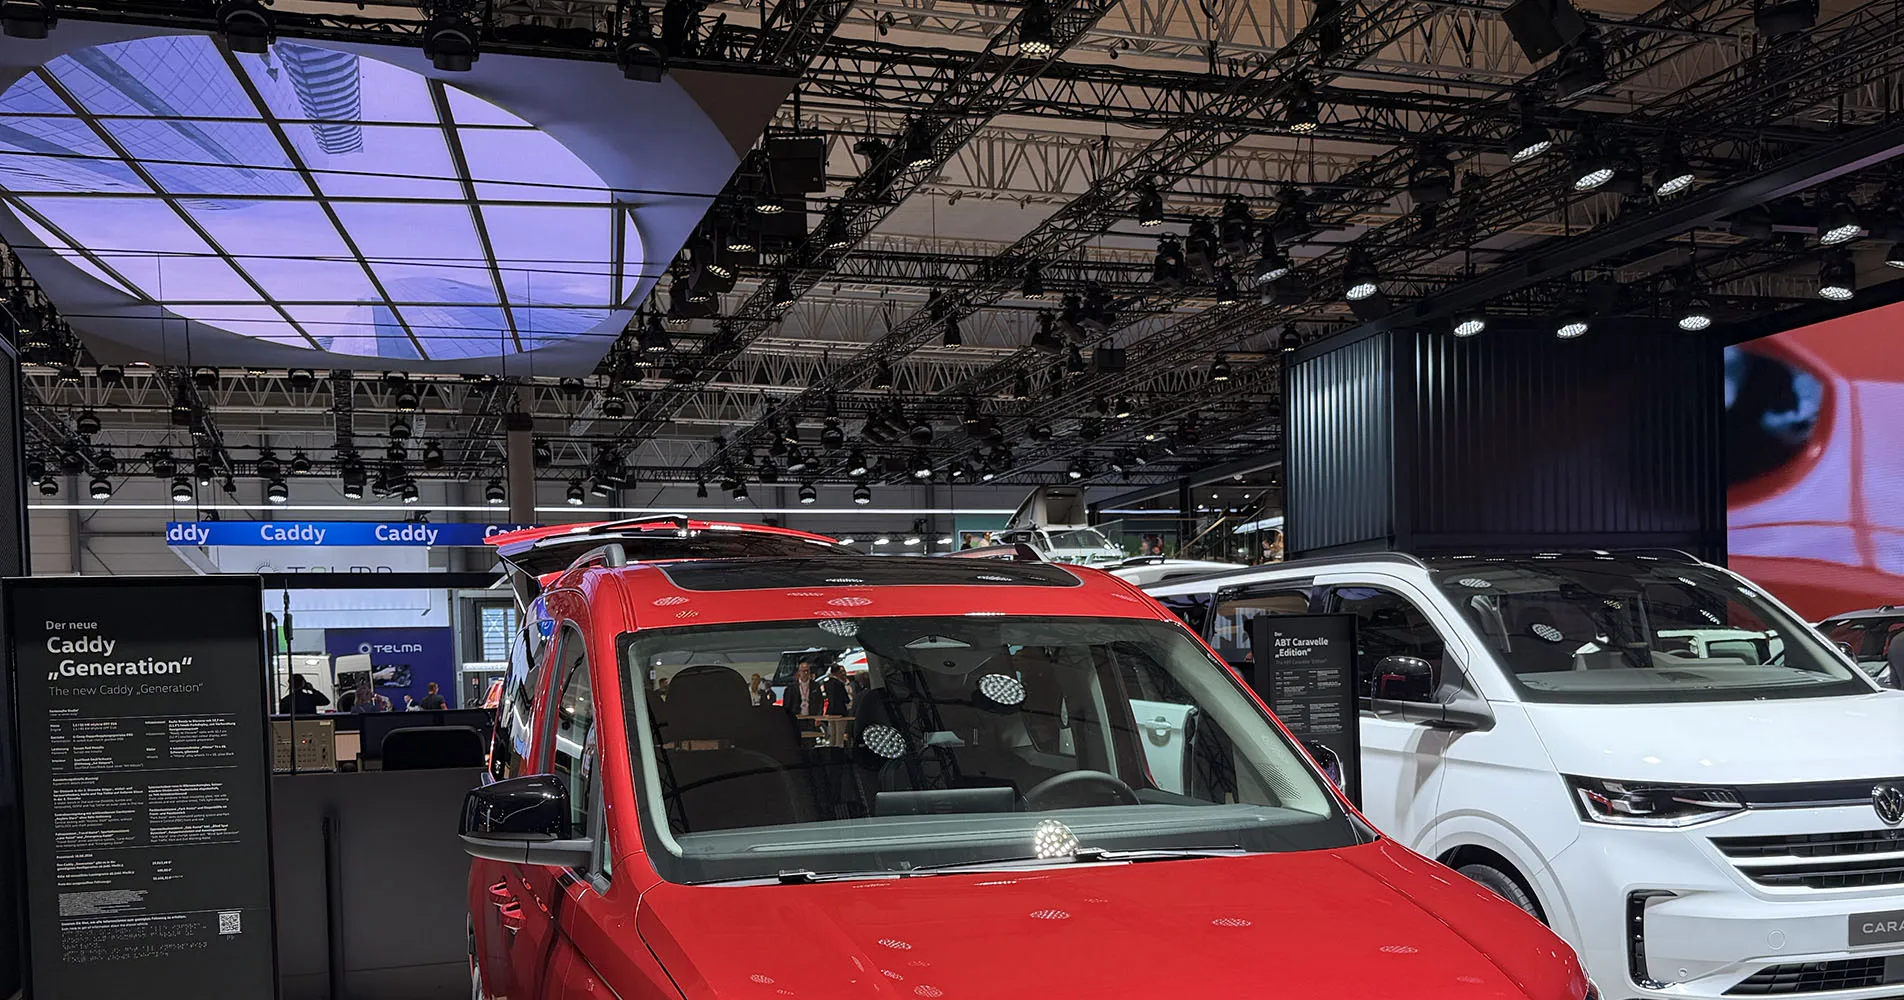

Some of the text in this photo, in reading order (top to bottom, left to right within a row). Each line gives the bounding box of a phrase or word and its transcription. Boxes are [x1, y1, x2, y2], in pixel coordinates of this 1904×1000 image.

[260, 524, 326, 545] Caddy
[375, 524, 438, 545] Caddy
[45, 621, 98, 630] Der neue
[46, 635, 116, 656] Caddy
[1274, 637, 1329, 647] ABT Caravelle
[48, 686, 70, 696] The
[72, 687, 97, 696] new
[99, 684, 134, 697] Caddy
